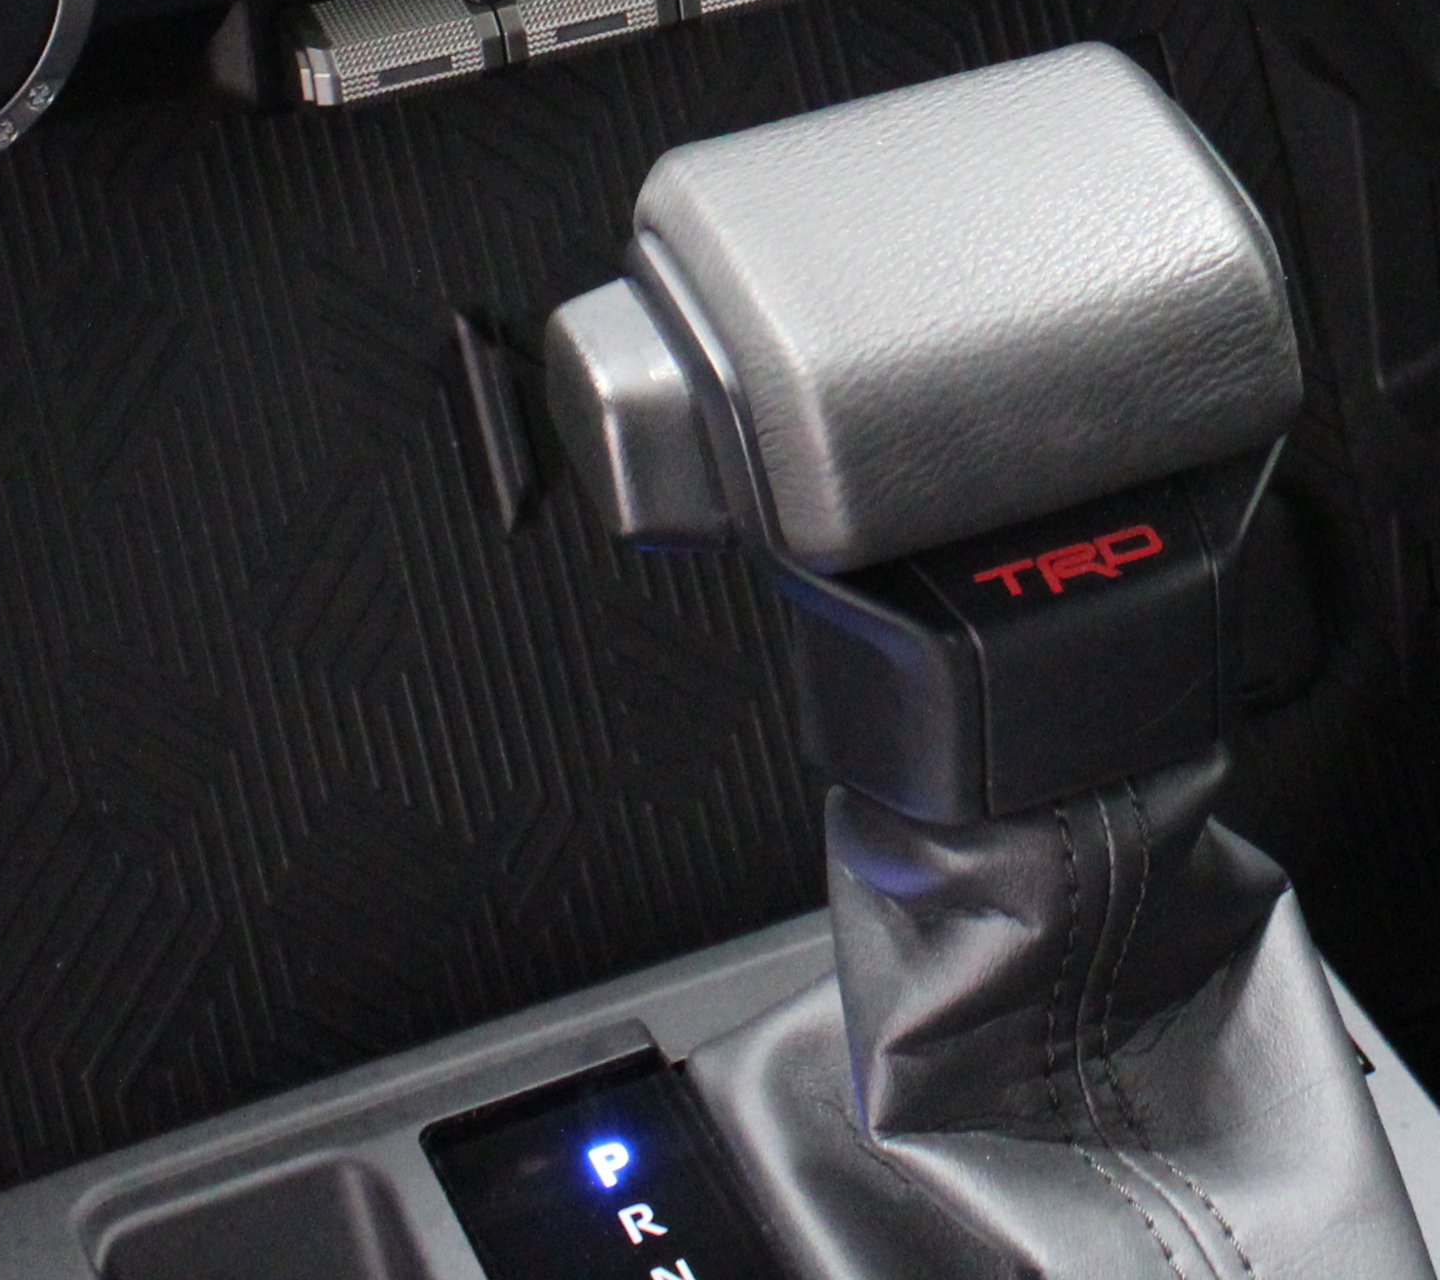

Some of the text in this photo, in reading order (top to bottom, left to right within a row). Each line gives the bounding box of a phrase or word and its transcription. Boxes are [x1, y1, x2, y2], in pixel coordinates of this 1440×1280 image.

[972, 523, 1164, 596] TRD
[588, 1141, 630, 1188] P
[617, 1202, 669, 1245] R
